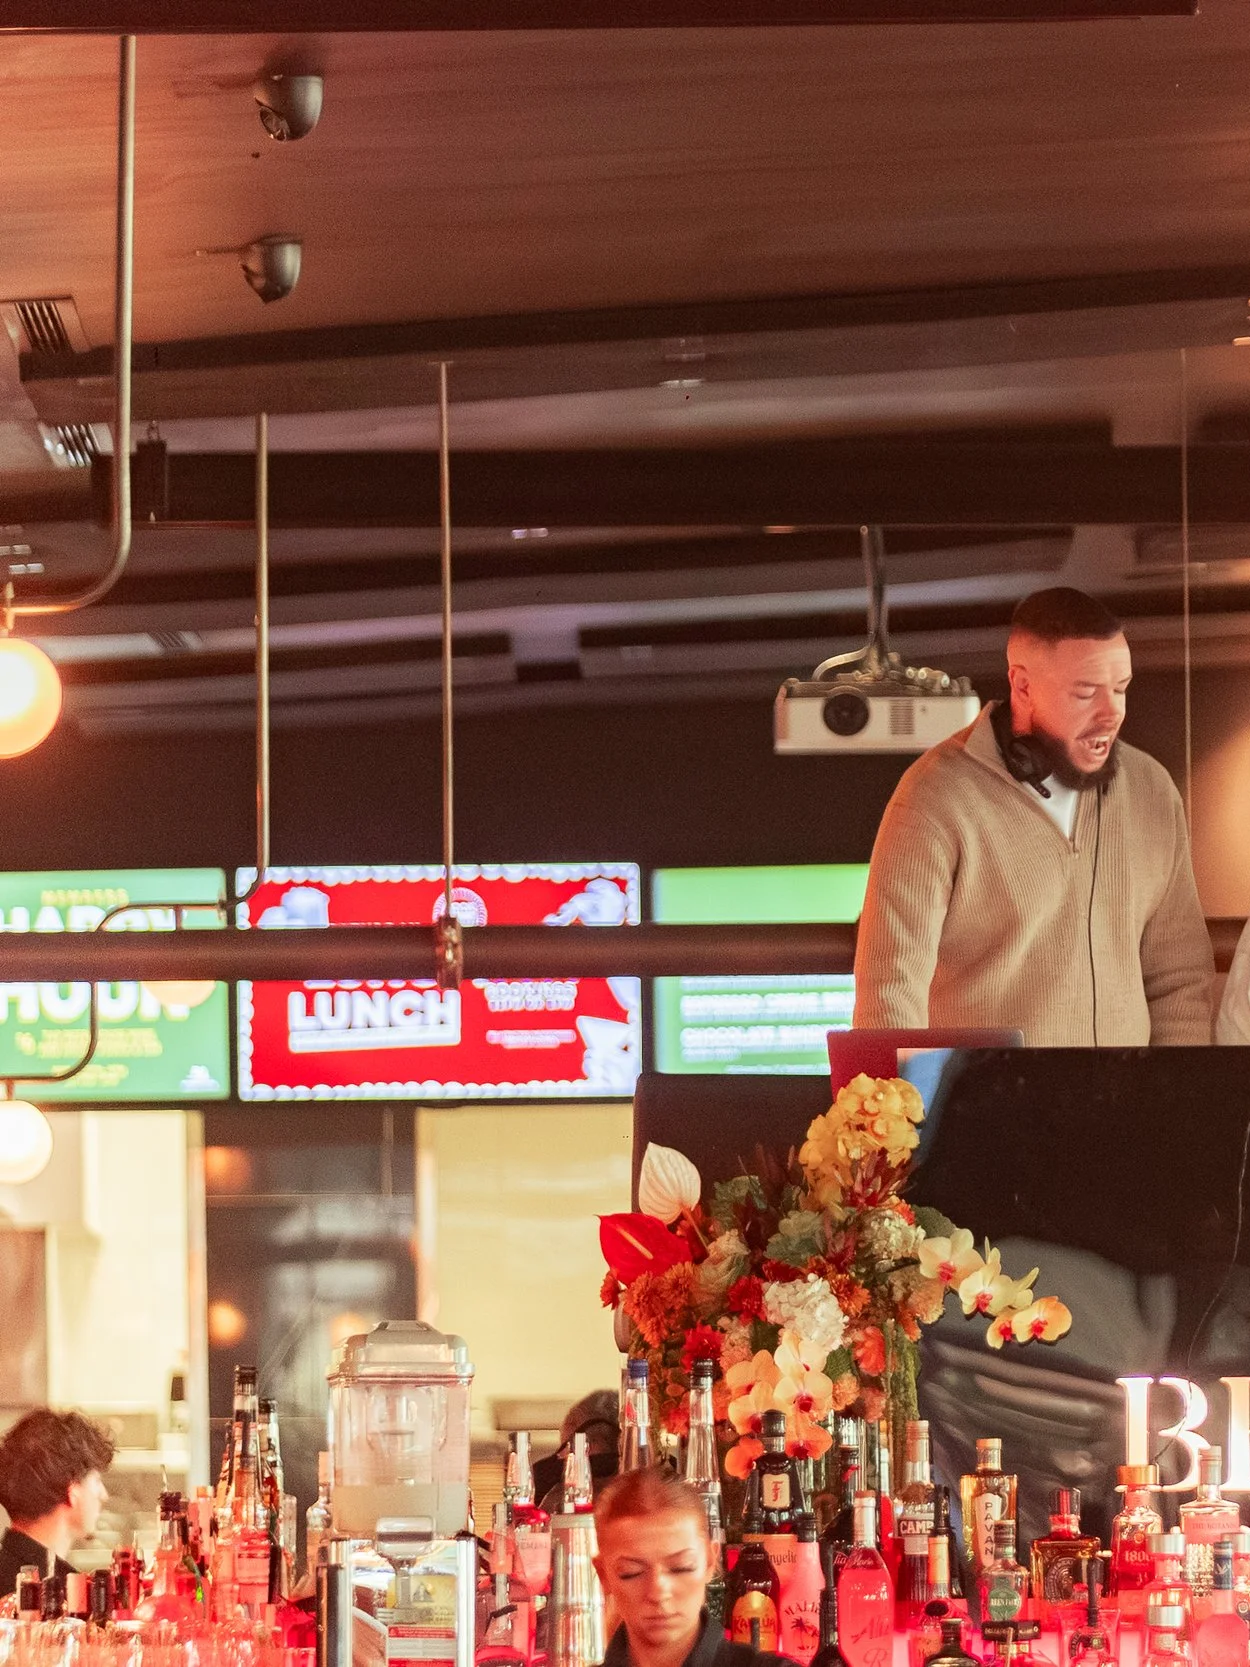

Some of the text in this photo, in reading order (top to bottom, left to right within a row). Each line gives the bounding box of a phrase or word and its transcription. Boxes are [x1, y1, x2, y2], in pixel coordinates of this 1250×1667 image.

[288, 989, 461, 1031] LUNCH
[900, 1520, 935, 1534] CAMP
[984, 1501, 995, 1555] PAVAN
